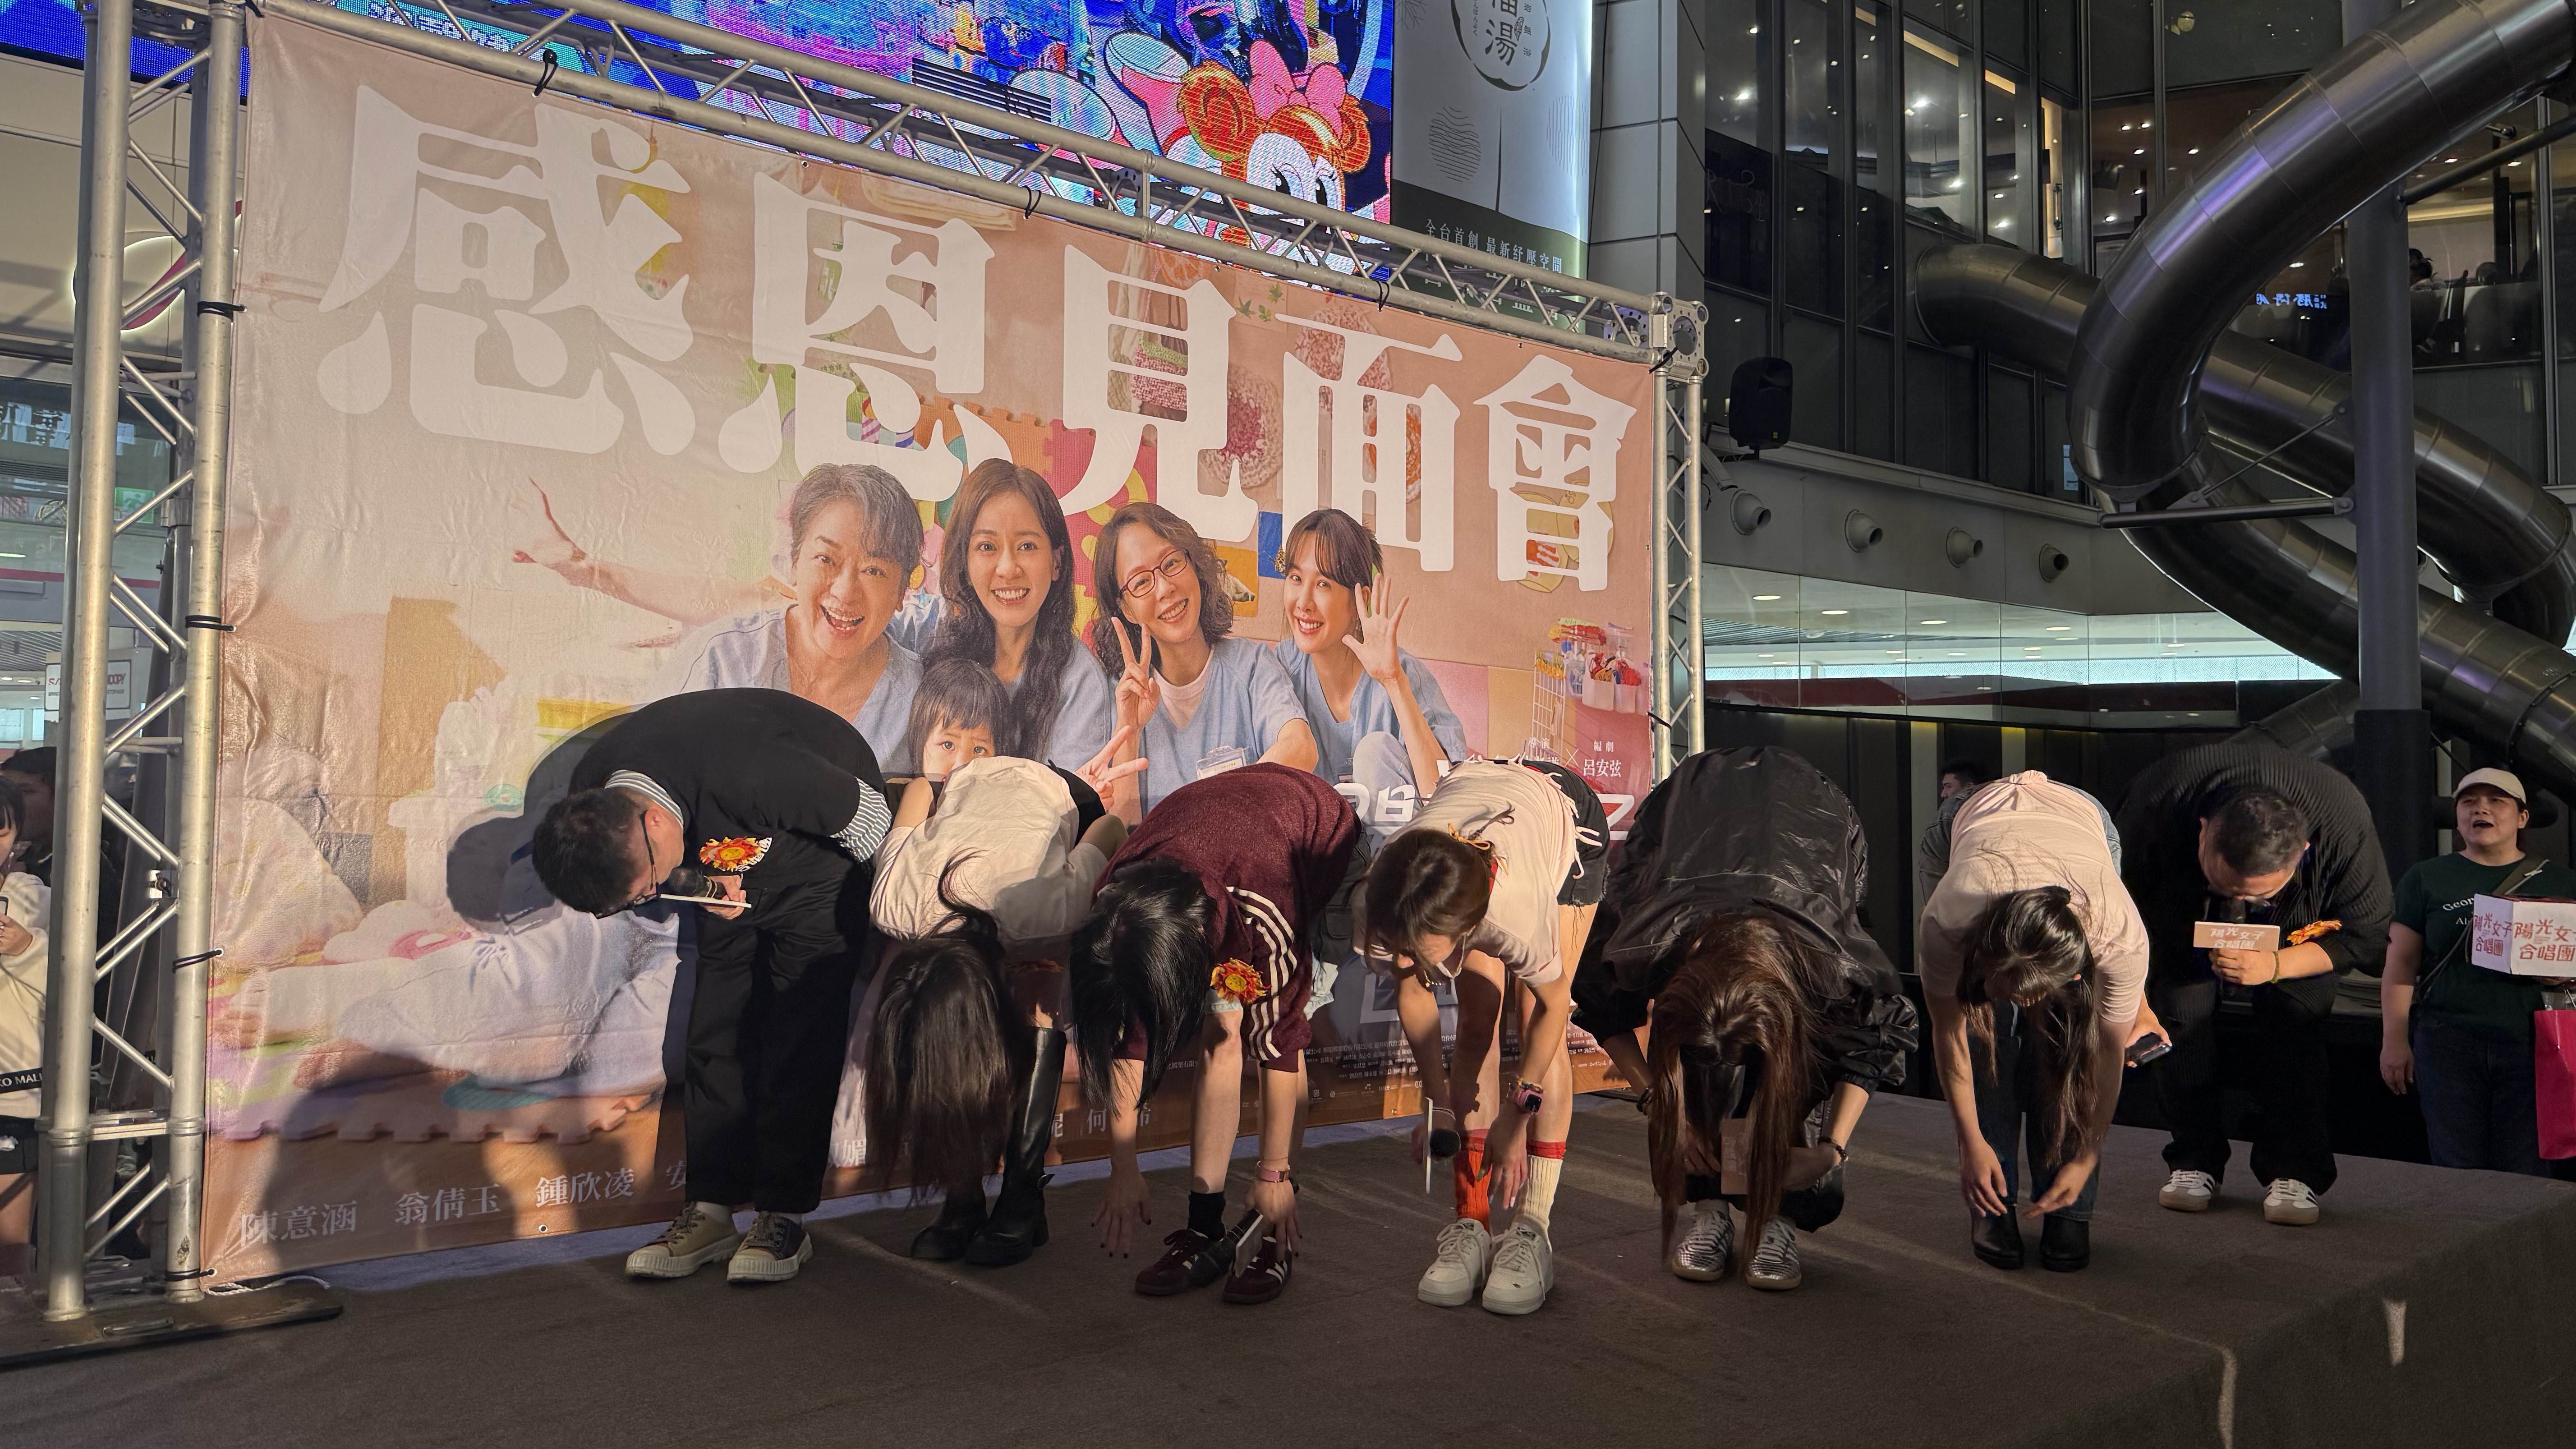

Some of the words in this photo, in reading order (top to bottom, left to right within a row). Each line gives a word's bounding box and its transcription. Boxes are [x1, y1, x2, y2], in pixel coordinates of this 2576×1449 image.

[1486, 236, 1562, 274] 最新紓壓空間
[317, 82, 1637, 593] 感恩見面會
[1583, 759, 1622, 777] 呂安弦
[2210, 927, 2265, 940] 陽光女子
[2474, 912, 2512, 938] 陽光女子
[2514, 918, 2576, 942] 陽光女
[2475, 936, 2503, 957] 合唱團
[2519, 943, 2576, 962] 合唱團
[240, 1199, 358, 1247] 陳意涵
[394, 1182, 501, 1226] 翁倩玉
[534, 1168, 635, 1209] 鍾欣凌
